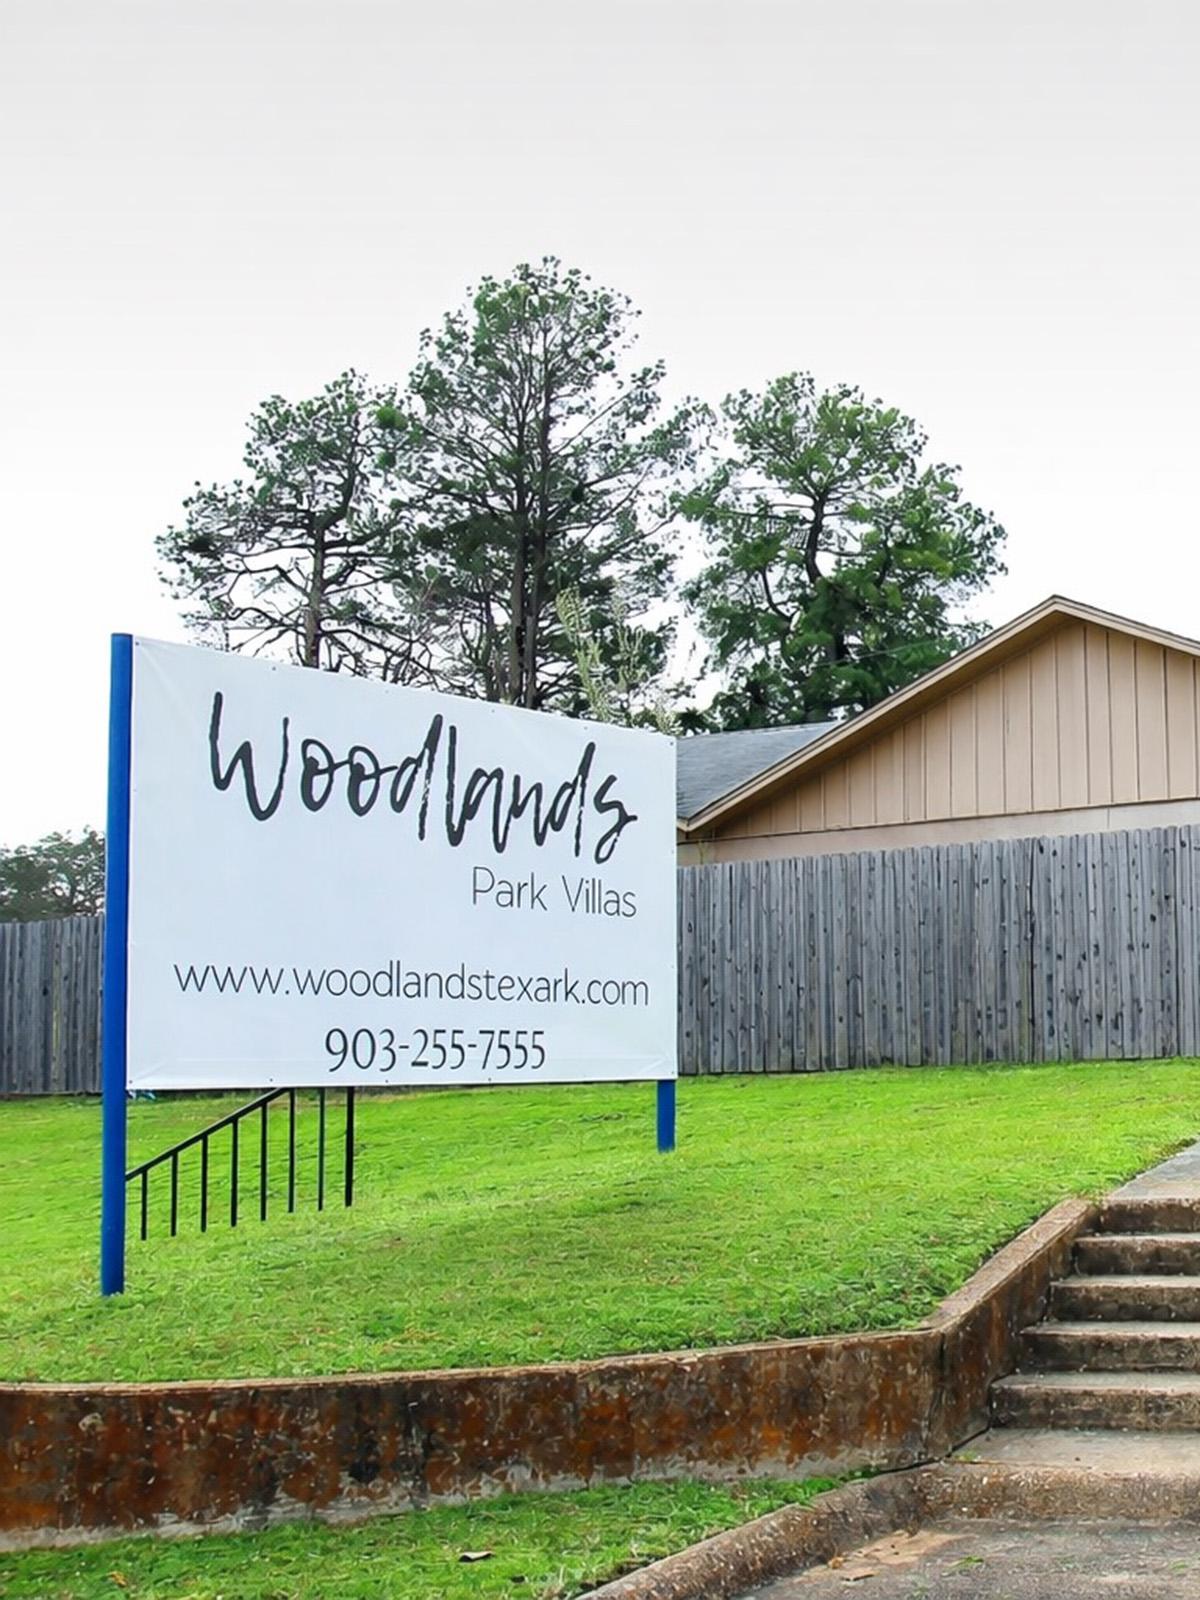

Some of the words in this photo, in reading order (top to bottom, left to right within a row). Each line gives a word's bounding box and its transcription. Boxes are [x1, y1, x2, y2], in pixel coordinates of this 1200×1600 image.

[208, 690, 639, 865] Woodlands
[472, 866, 548, 911] Park
[561, 875, 637, 918] Villas
[173, 960, 649, 1006] www.woodlandstexark.com
[324, 1027, 546, 1072] 903-255-7555
